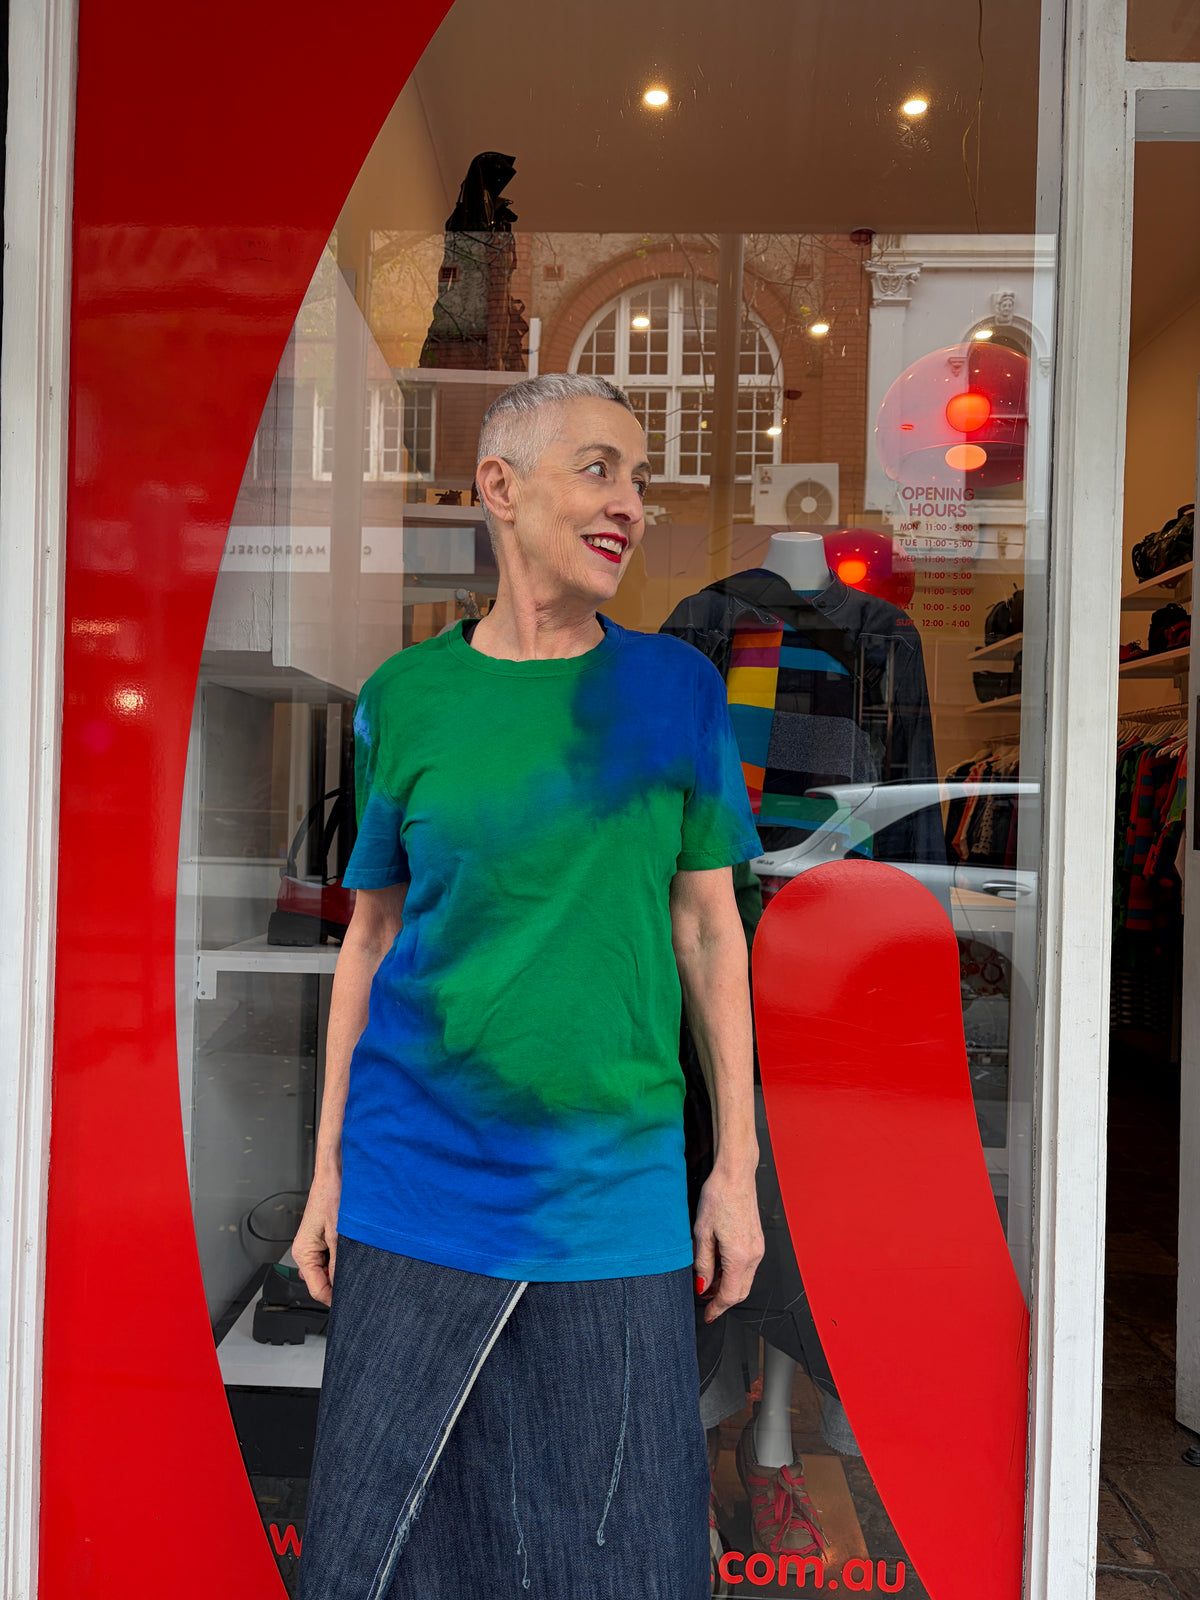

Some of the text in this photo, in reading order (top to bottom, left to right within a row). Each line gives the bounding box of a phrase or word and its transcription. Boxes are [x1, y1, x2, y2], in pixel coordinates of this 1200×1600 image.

[902, 487, 975, 501] OPENING
[909, 503, 967, 517] HOURS
[900, 523, 919, 531] MON
[925, 523, 947, 531] 11:00
[954, 524, 974, 532] 5:00
[899, 538, 917, 547] TUE
[925, 539, 947, 547] 11:00
[954, 540, 973, 548] 5:00
[924, 555, 946, 563] 11:00
[953, 556, 973, 564] 5:00
[924, 571, 945, 579] 11:00
[953, 572, 972, 580] 5:00
[952, 603, 971, 611] 5:00
[896, 619, 914, 627] SUN
[922, 619, 944, 627] 12:00
[951, 620, 970, 628] 4:00
